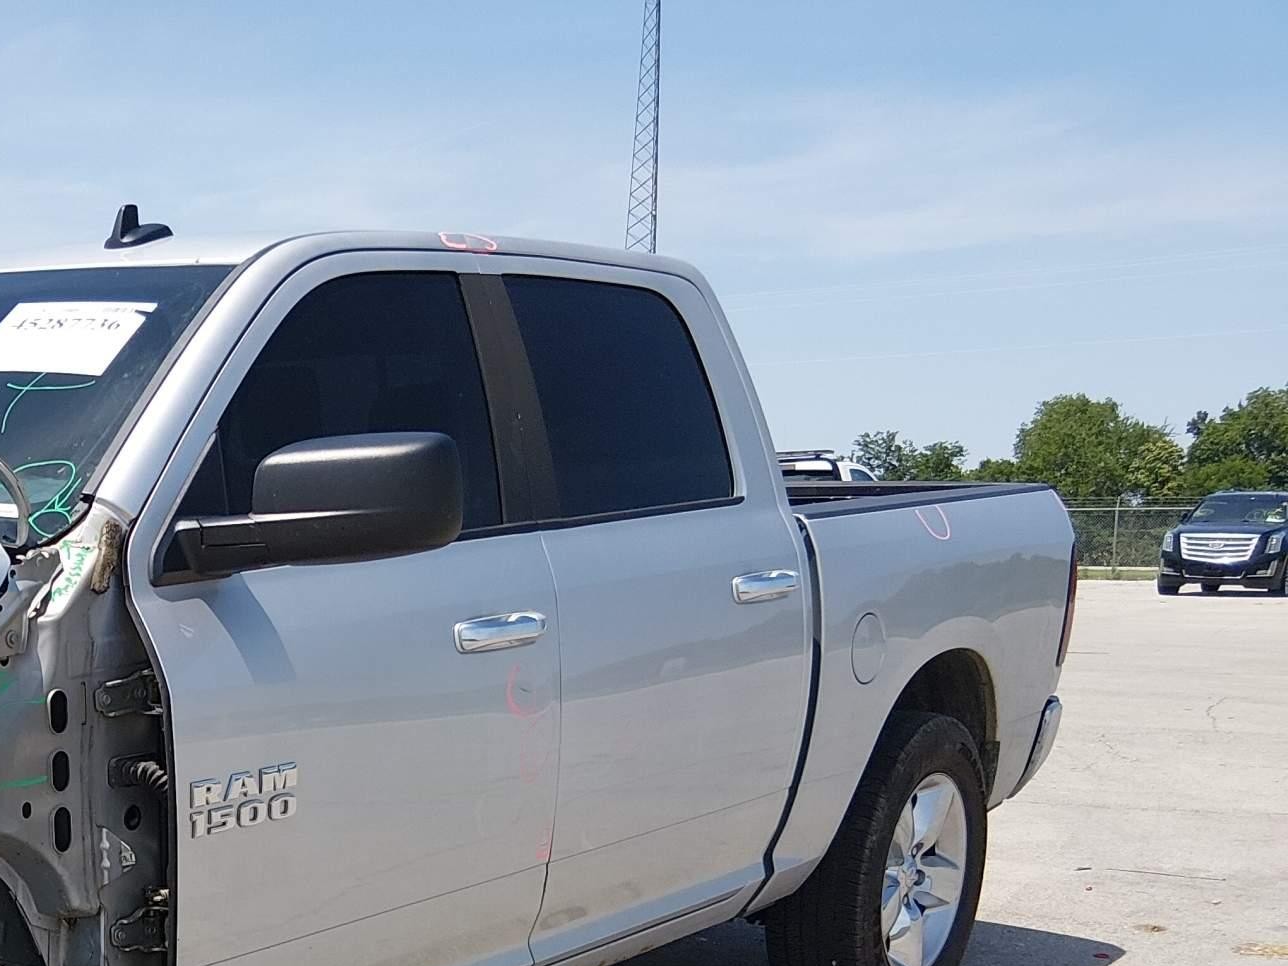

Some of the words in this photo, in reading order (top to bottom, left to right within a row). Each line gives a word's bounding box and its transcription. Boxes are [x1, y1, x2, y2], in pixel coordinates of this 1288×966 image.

[12, 317, 122, 330] 45287736
[190, 762, 297, 809] RAM
[190, 792, 297, 839] 1500
